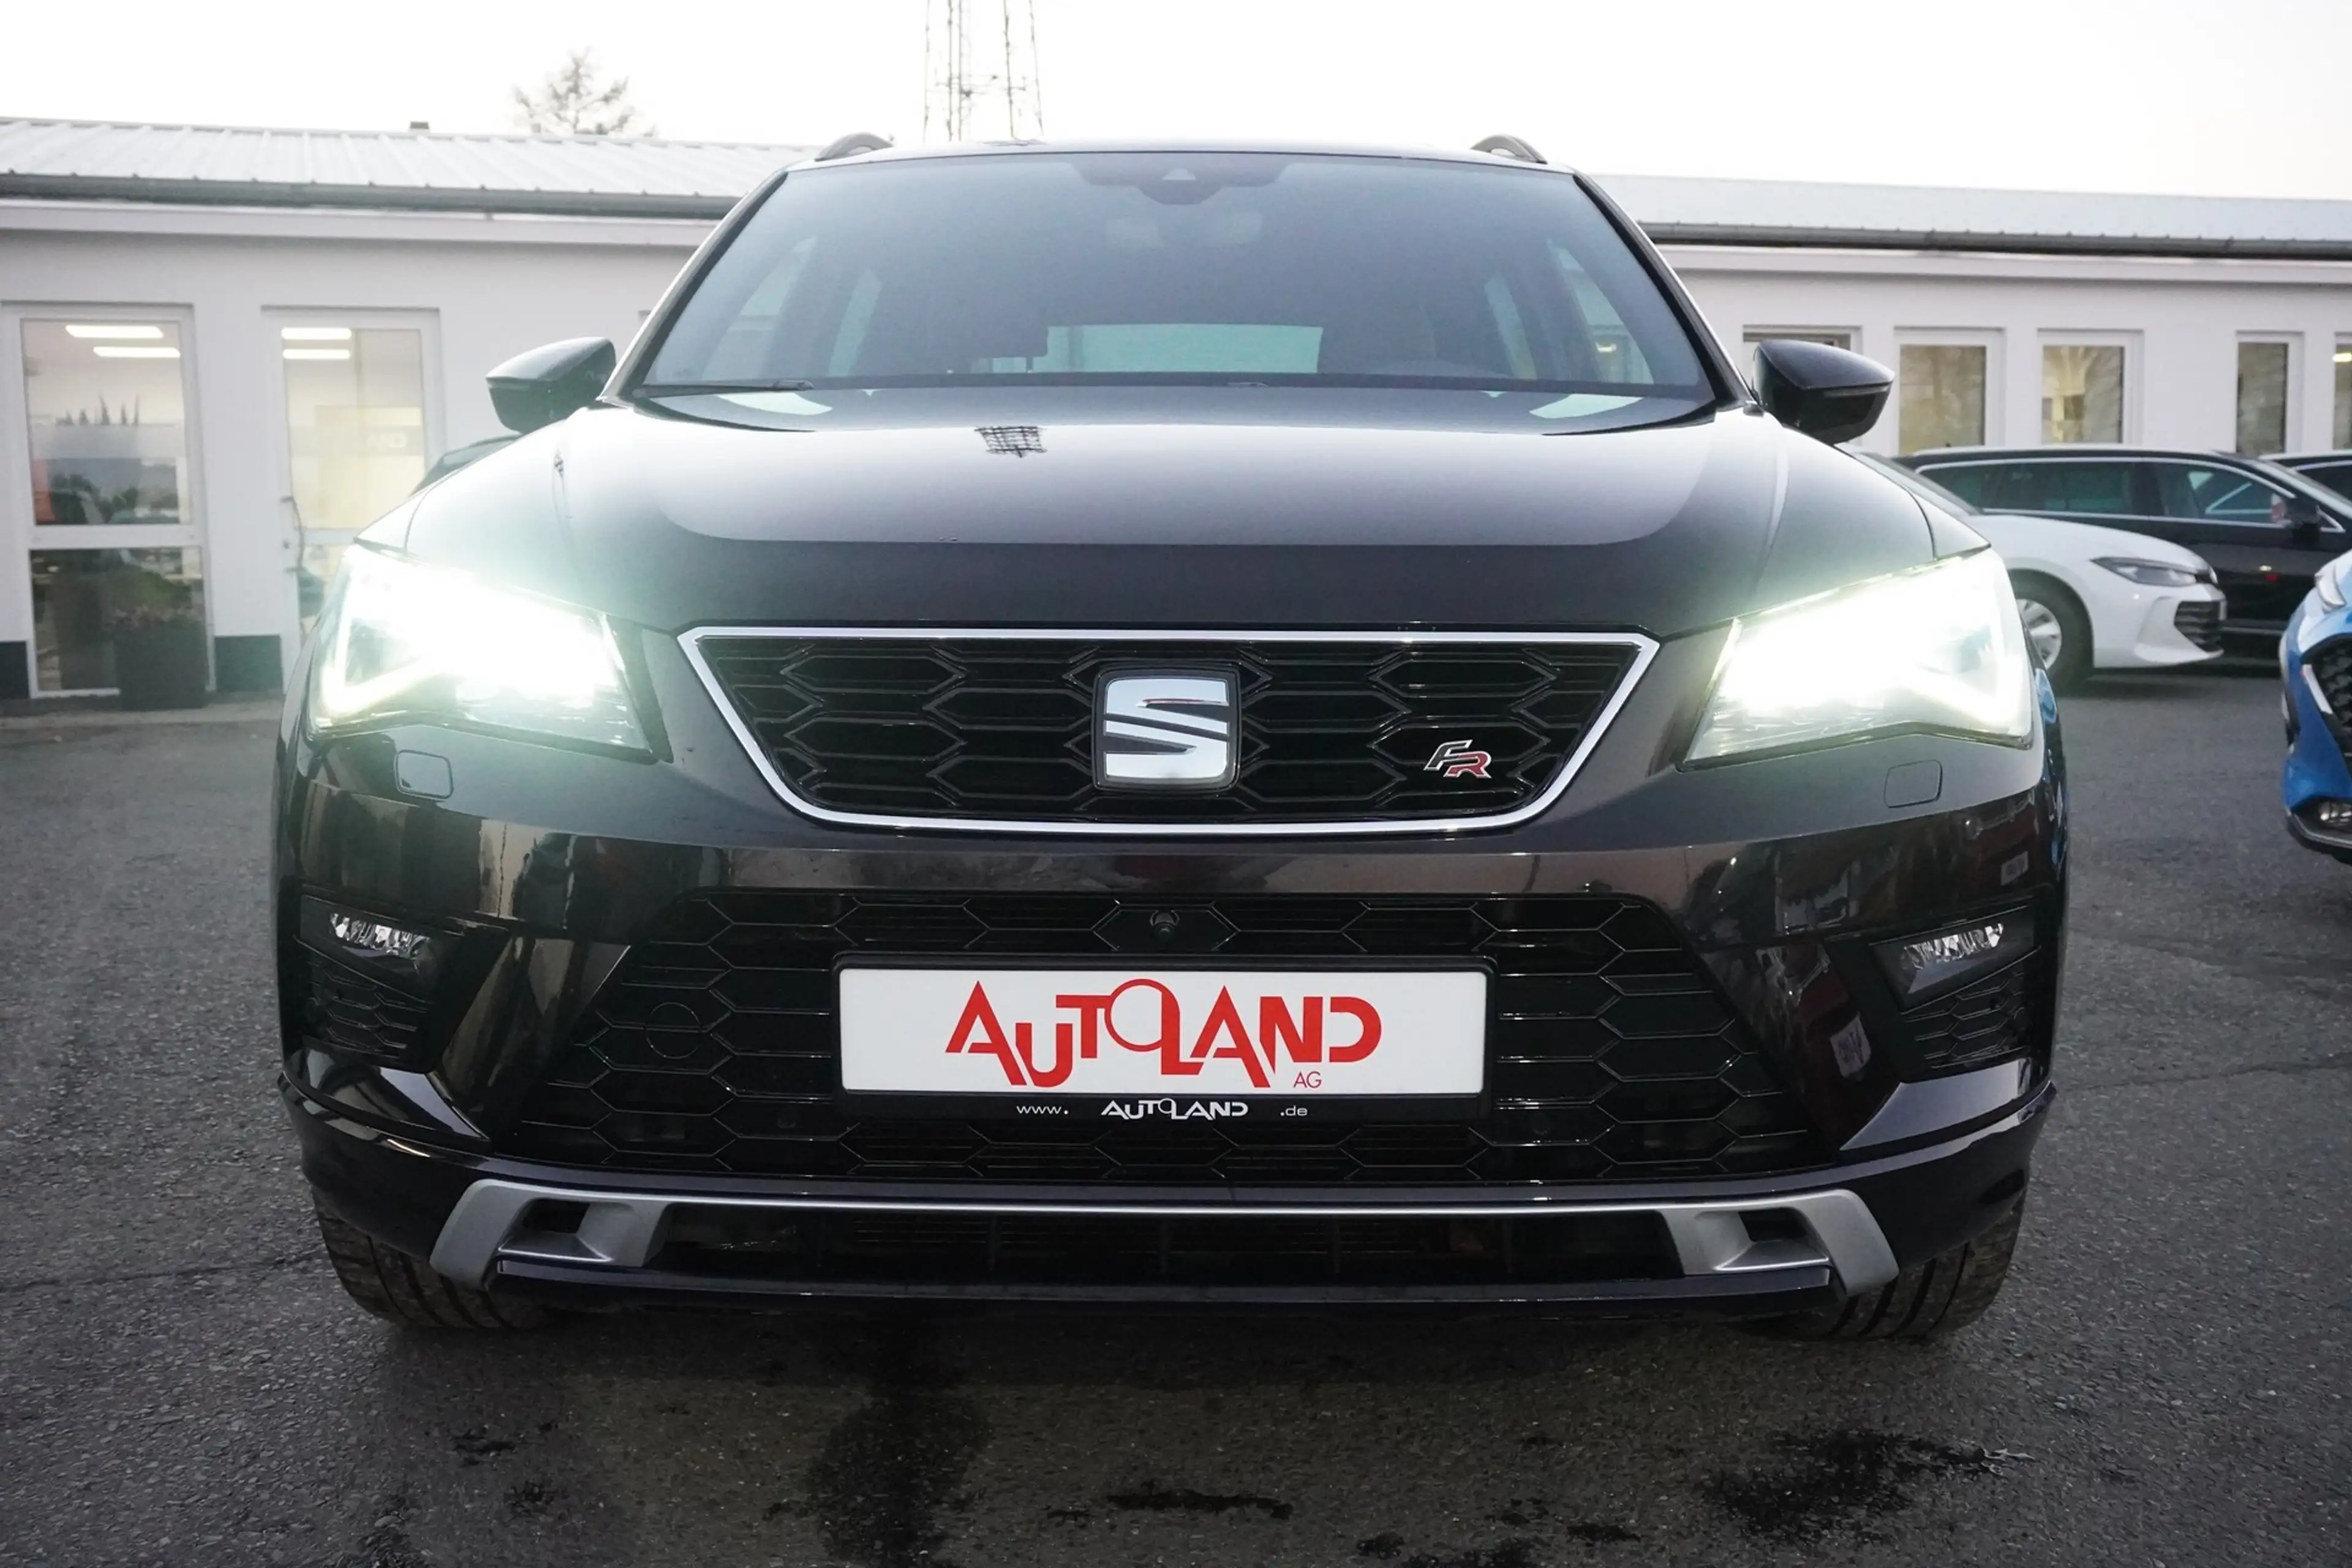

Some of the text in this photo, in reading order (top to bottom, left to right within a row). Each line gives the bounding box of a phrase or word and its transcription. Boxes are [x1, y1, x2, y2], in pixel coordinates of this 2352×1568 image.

[1423, 739, 1492, 778] FR
[946, 979, 1382, 1088] AUTOLAND
[1293, 1071, 1322, 1088] AG
[1016, 1097, 1308, 1121] www. AUTOLAND .de
